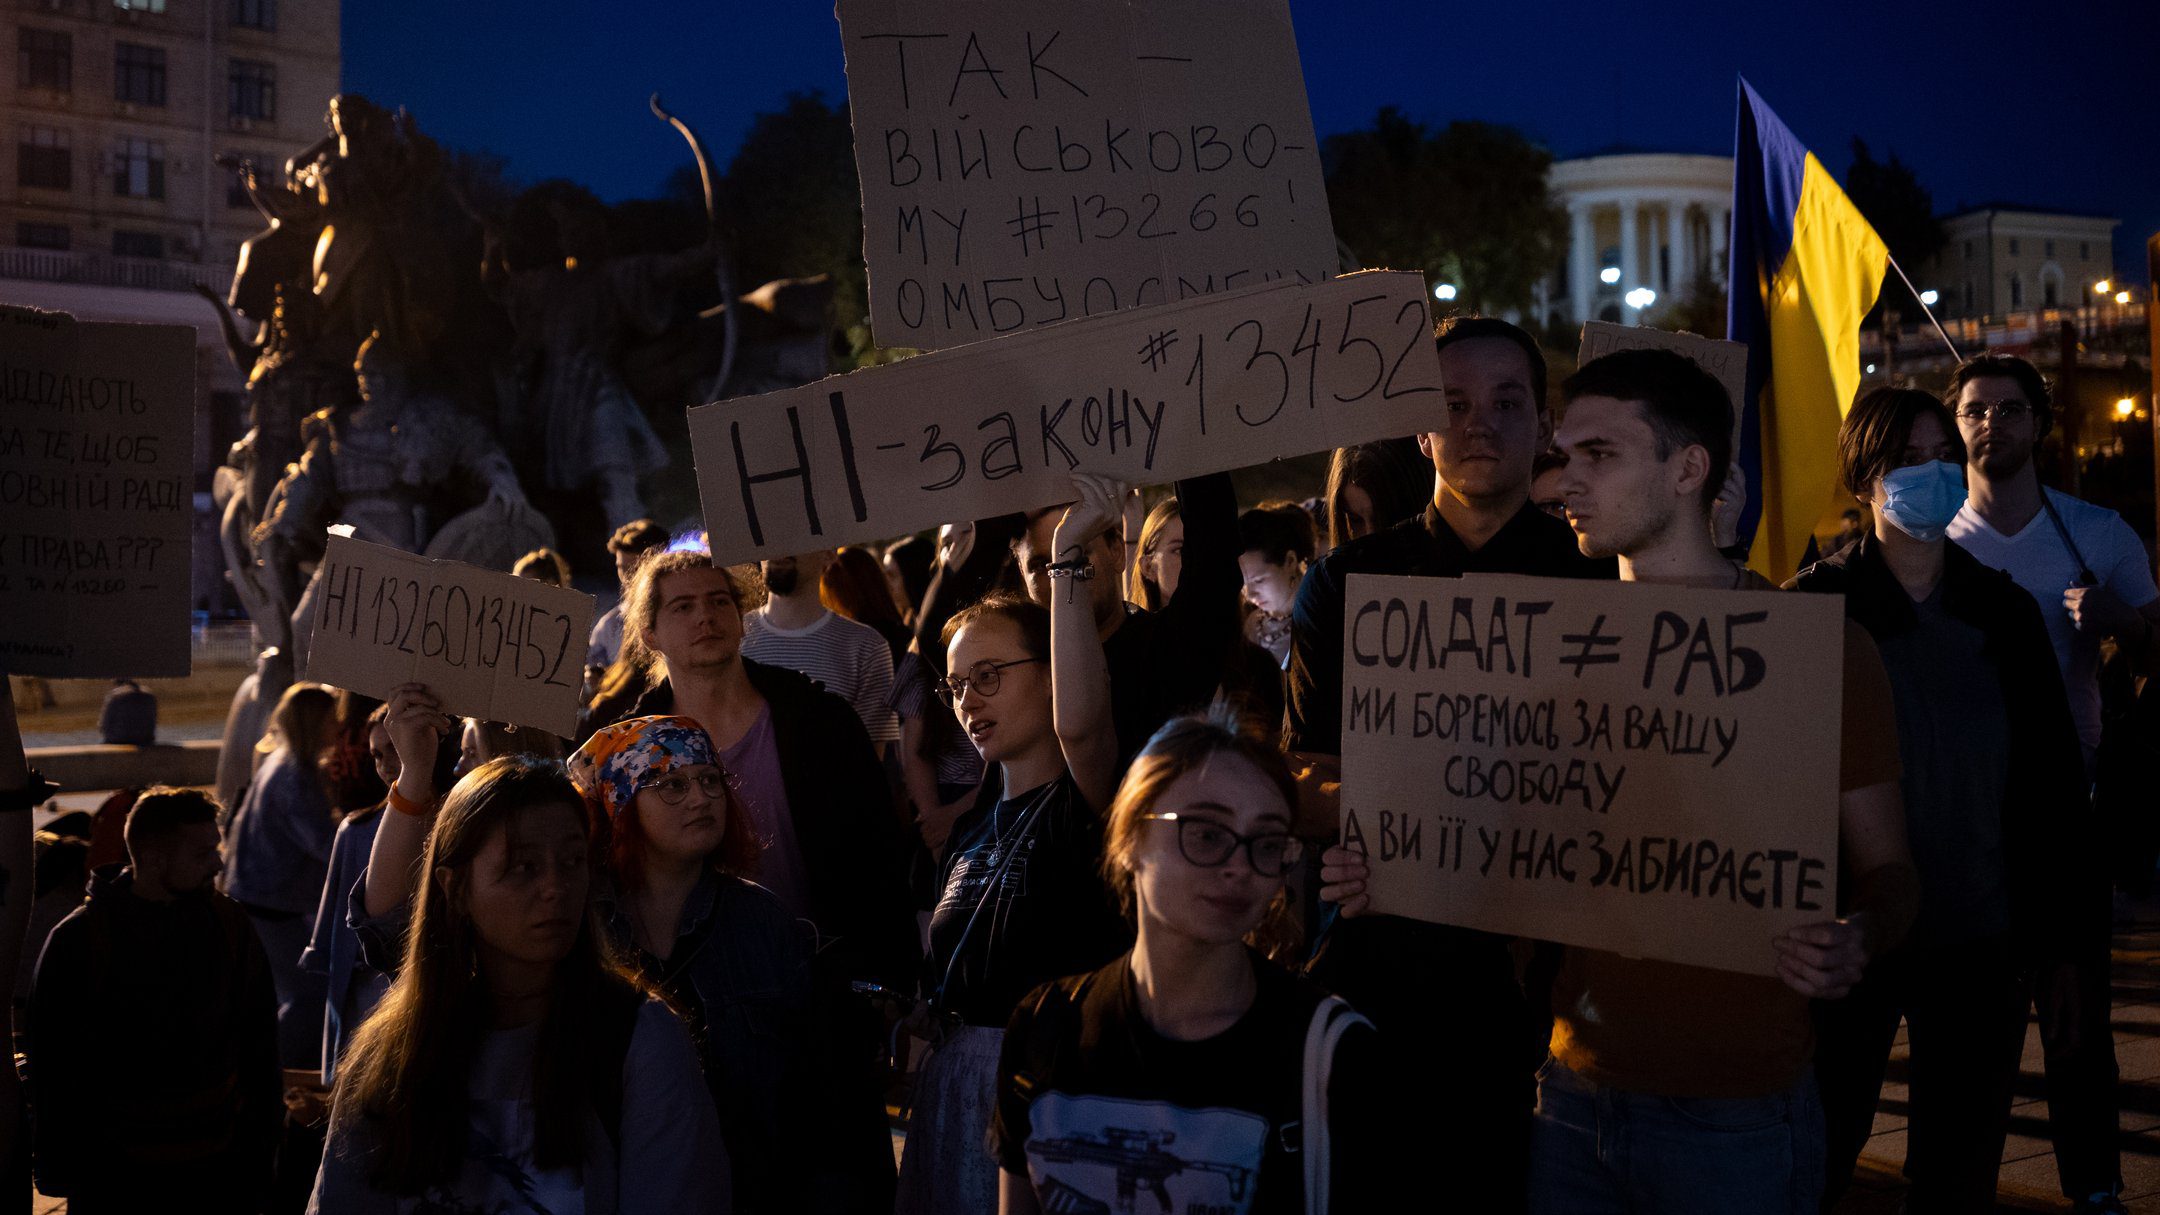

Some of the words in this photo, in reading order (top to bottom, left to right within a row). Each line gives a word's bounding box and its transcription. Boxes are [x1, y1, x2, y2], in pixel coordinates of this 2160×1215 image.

[860, 31, 1089, 108] ТАК
[885, 114, 1305, 187] ВІЙСЬКОВО-
[898, 205, 968, 266] МУ
[0, 361, 147, 415] ІДДАЮТЬ
[1138, 294, 1443, 436] #13452
[81, 433, 160, 469] ЩОБ
[0, 469, 110, 511] ОВНІЙ
[122, 475, 183, 513] РАДІ
[322, 563, 364, 639] НІ
[1351, 596, 1554, 678] СОЛДАТ
[1642, 610, 1769, 697] РАБ
[1349, 686, 1396, 735] МИ
[1412, 691, 1560, 751] БОРЕМОСЬ
[1571, 699, 1613, 752] ЗА
[1624, 704, 1739, 768] ВАШУ
[1444, 754, 1626, 814] СВОБОДУ
[1342, 807, 1369, 858] А
[1379, 809, 1422, 863] ВИ
[1437, 814, 1467, 871] ЇЇ
[1477, 825, 1502, 878] У
[1507, 828, 1578, 883] НАС
[1586, 829, 1826, 912] ЗАБИРАЄТЕ
